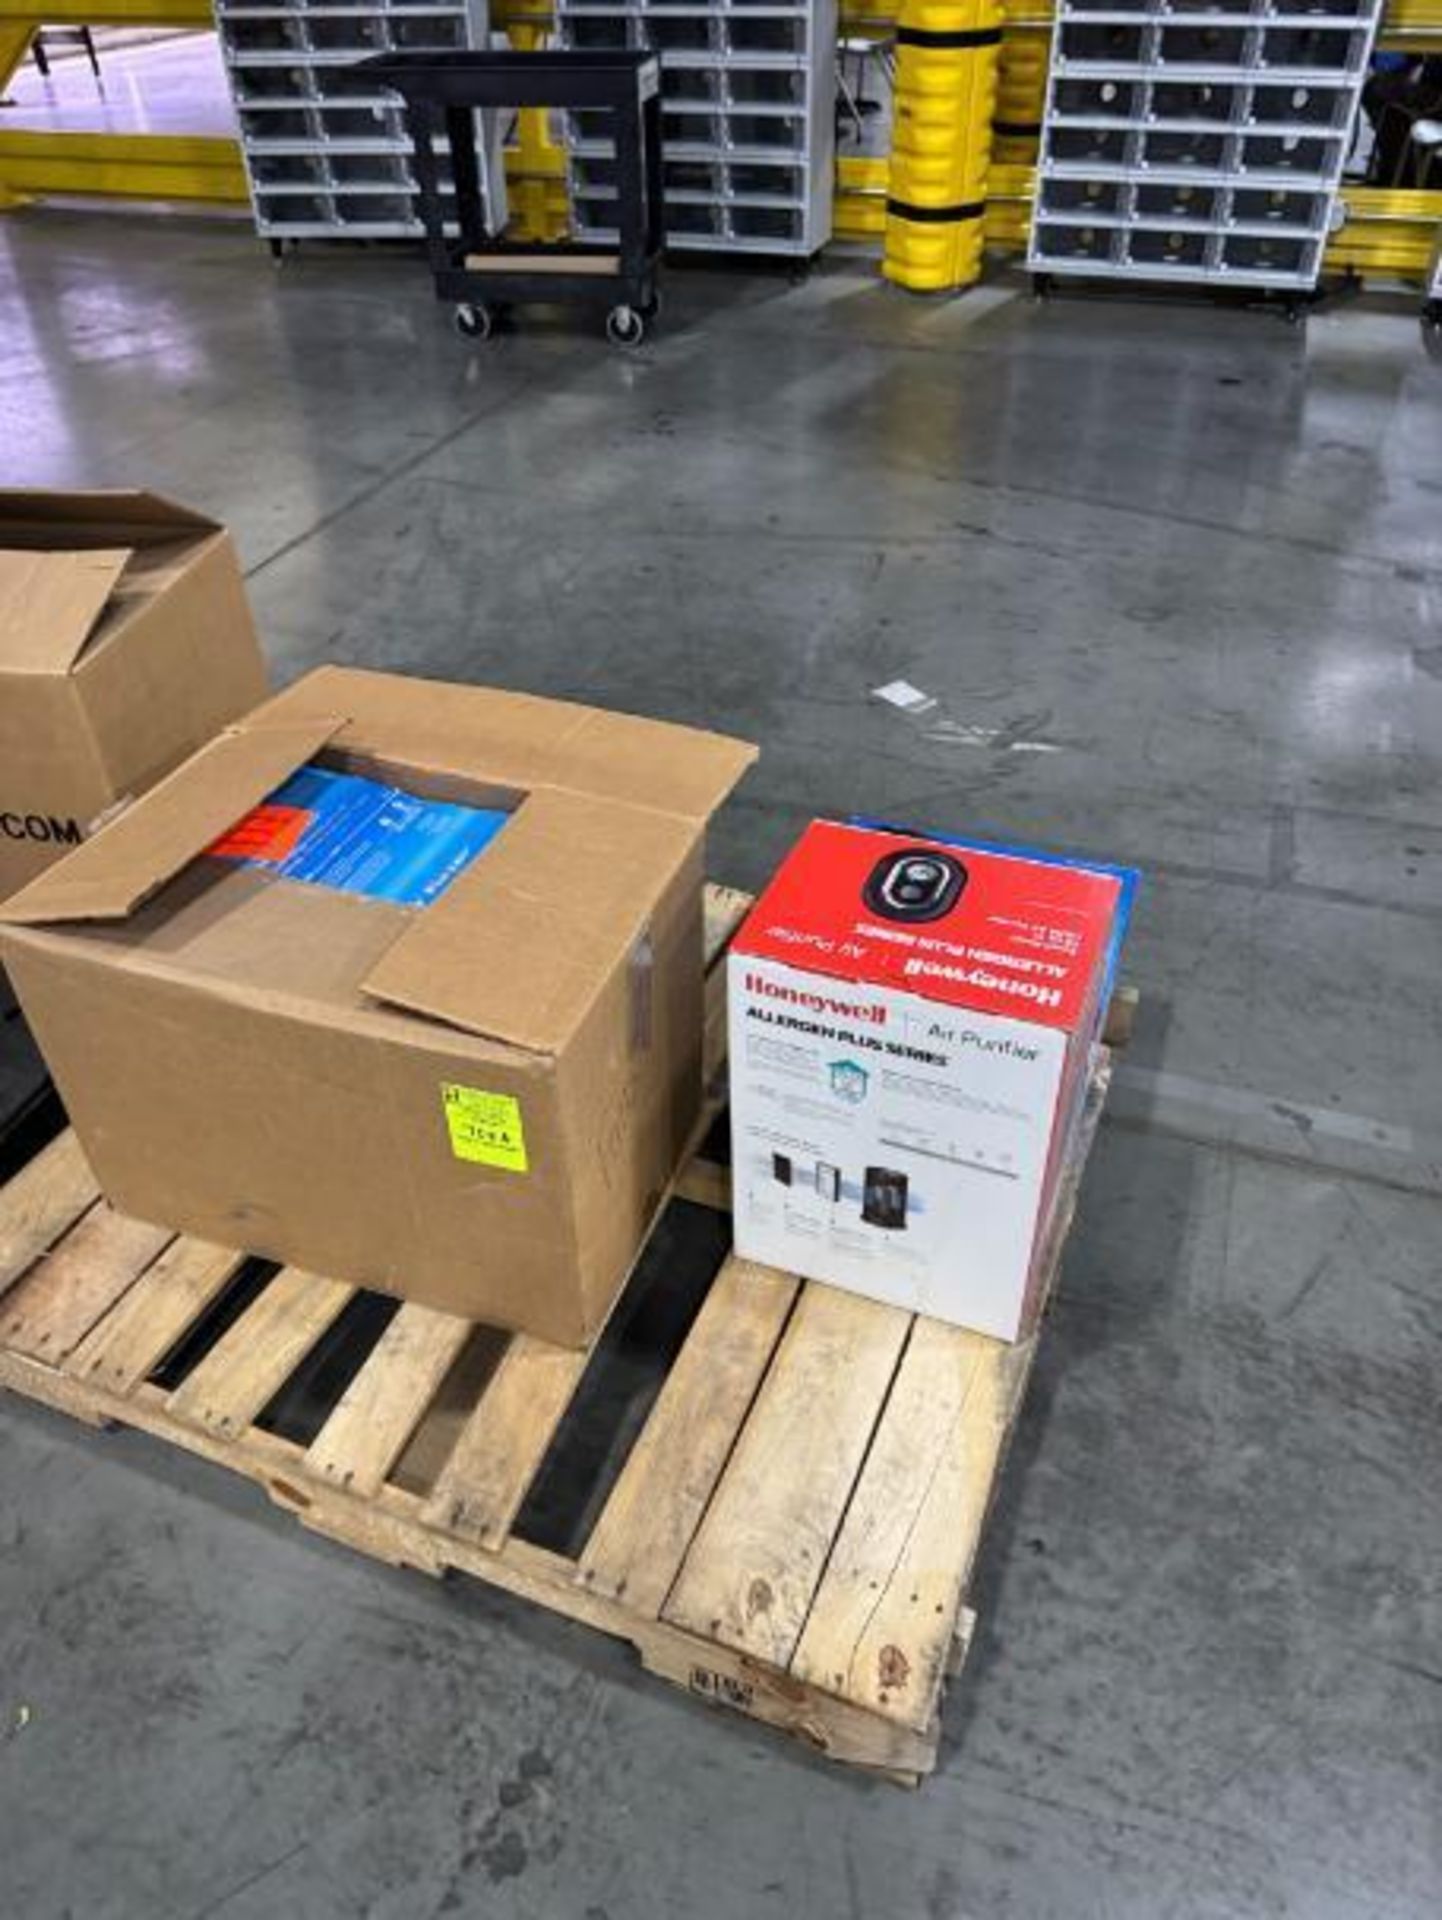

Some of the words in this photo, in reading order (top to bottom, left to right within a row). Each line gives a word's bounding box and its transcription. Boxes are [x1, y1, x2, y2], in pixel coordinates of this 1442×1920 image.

[904, 958, 1062, 1006] Honeywell
[967, 949, 1068, 978] ALLERGEN
[745, 973, 887, 1024] Honeywell
[928, 1023, 954, 1042] Air
[961, 1030, 1037, 1061] Purifier
[746, 1005, 836, 1042] ALLERGEN
[837, 1029, 884, 1052] PLUS
[885, 1043, 949, 1067] SERIES
